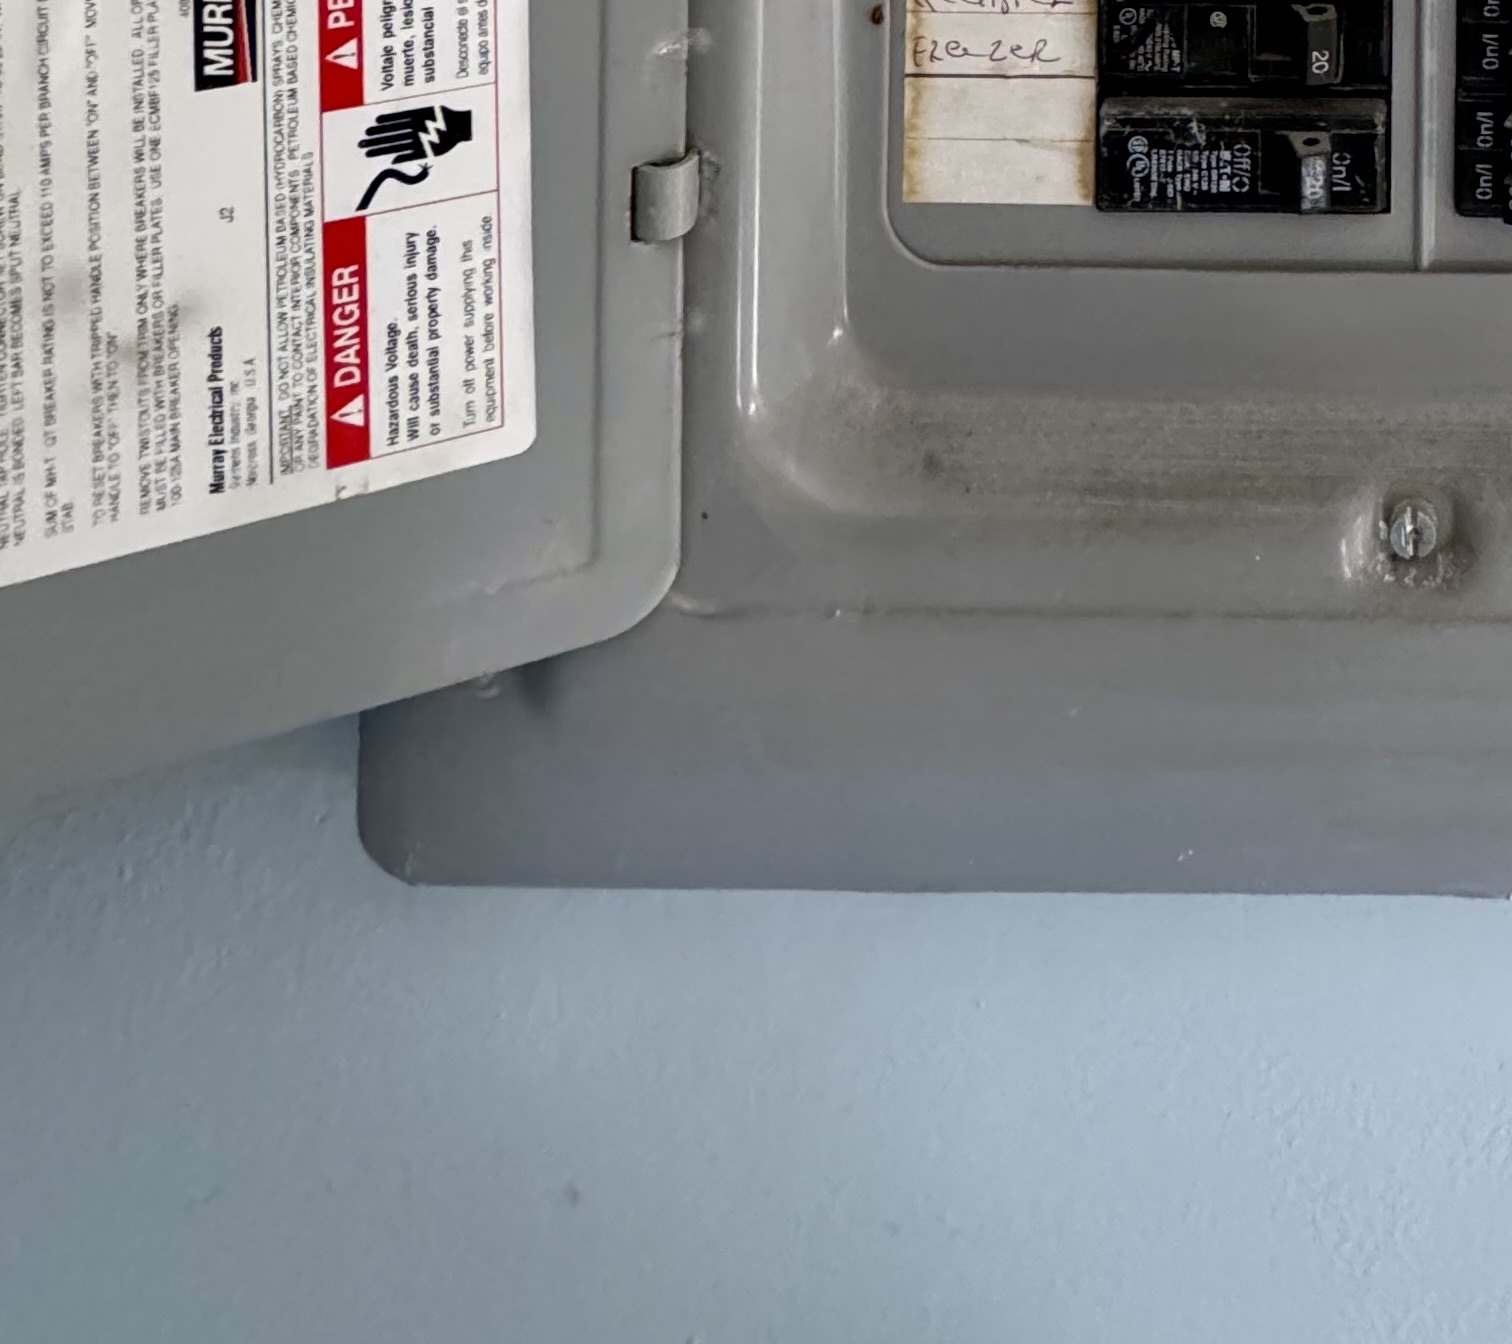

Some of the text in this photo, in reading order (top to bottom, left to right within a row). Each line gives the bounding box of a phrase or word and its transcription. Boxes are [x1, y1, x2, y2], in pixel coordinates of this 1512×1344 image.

[380, 45, 397, 92] Voltaje
[402, 34, 416, 87] muerte,
[421, 7, 436, 83] substancial
[1311, 50, 1330, 74] 20
[459, 239, 473, 262] this
[460, 268, 477, 327] supplying
[480, 257, 497, 306] working
[331, 264, 361, 387] DANGER
[404, 232, 420, 441] Will cause death, serious injury
[423, 225, 442, 436] or substantial property damage.
[462, 334, 478, 371] power
[481, 313, 495, 351] before
[208, 326, 228, 494] Murray Electrical Products
[384, 318, 400, 446] Hazardous Voltage.
[483, 358, 498, 423] equipment
[462, 400, 476, 428] Turn
